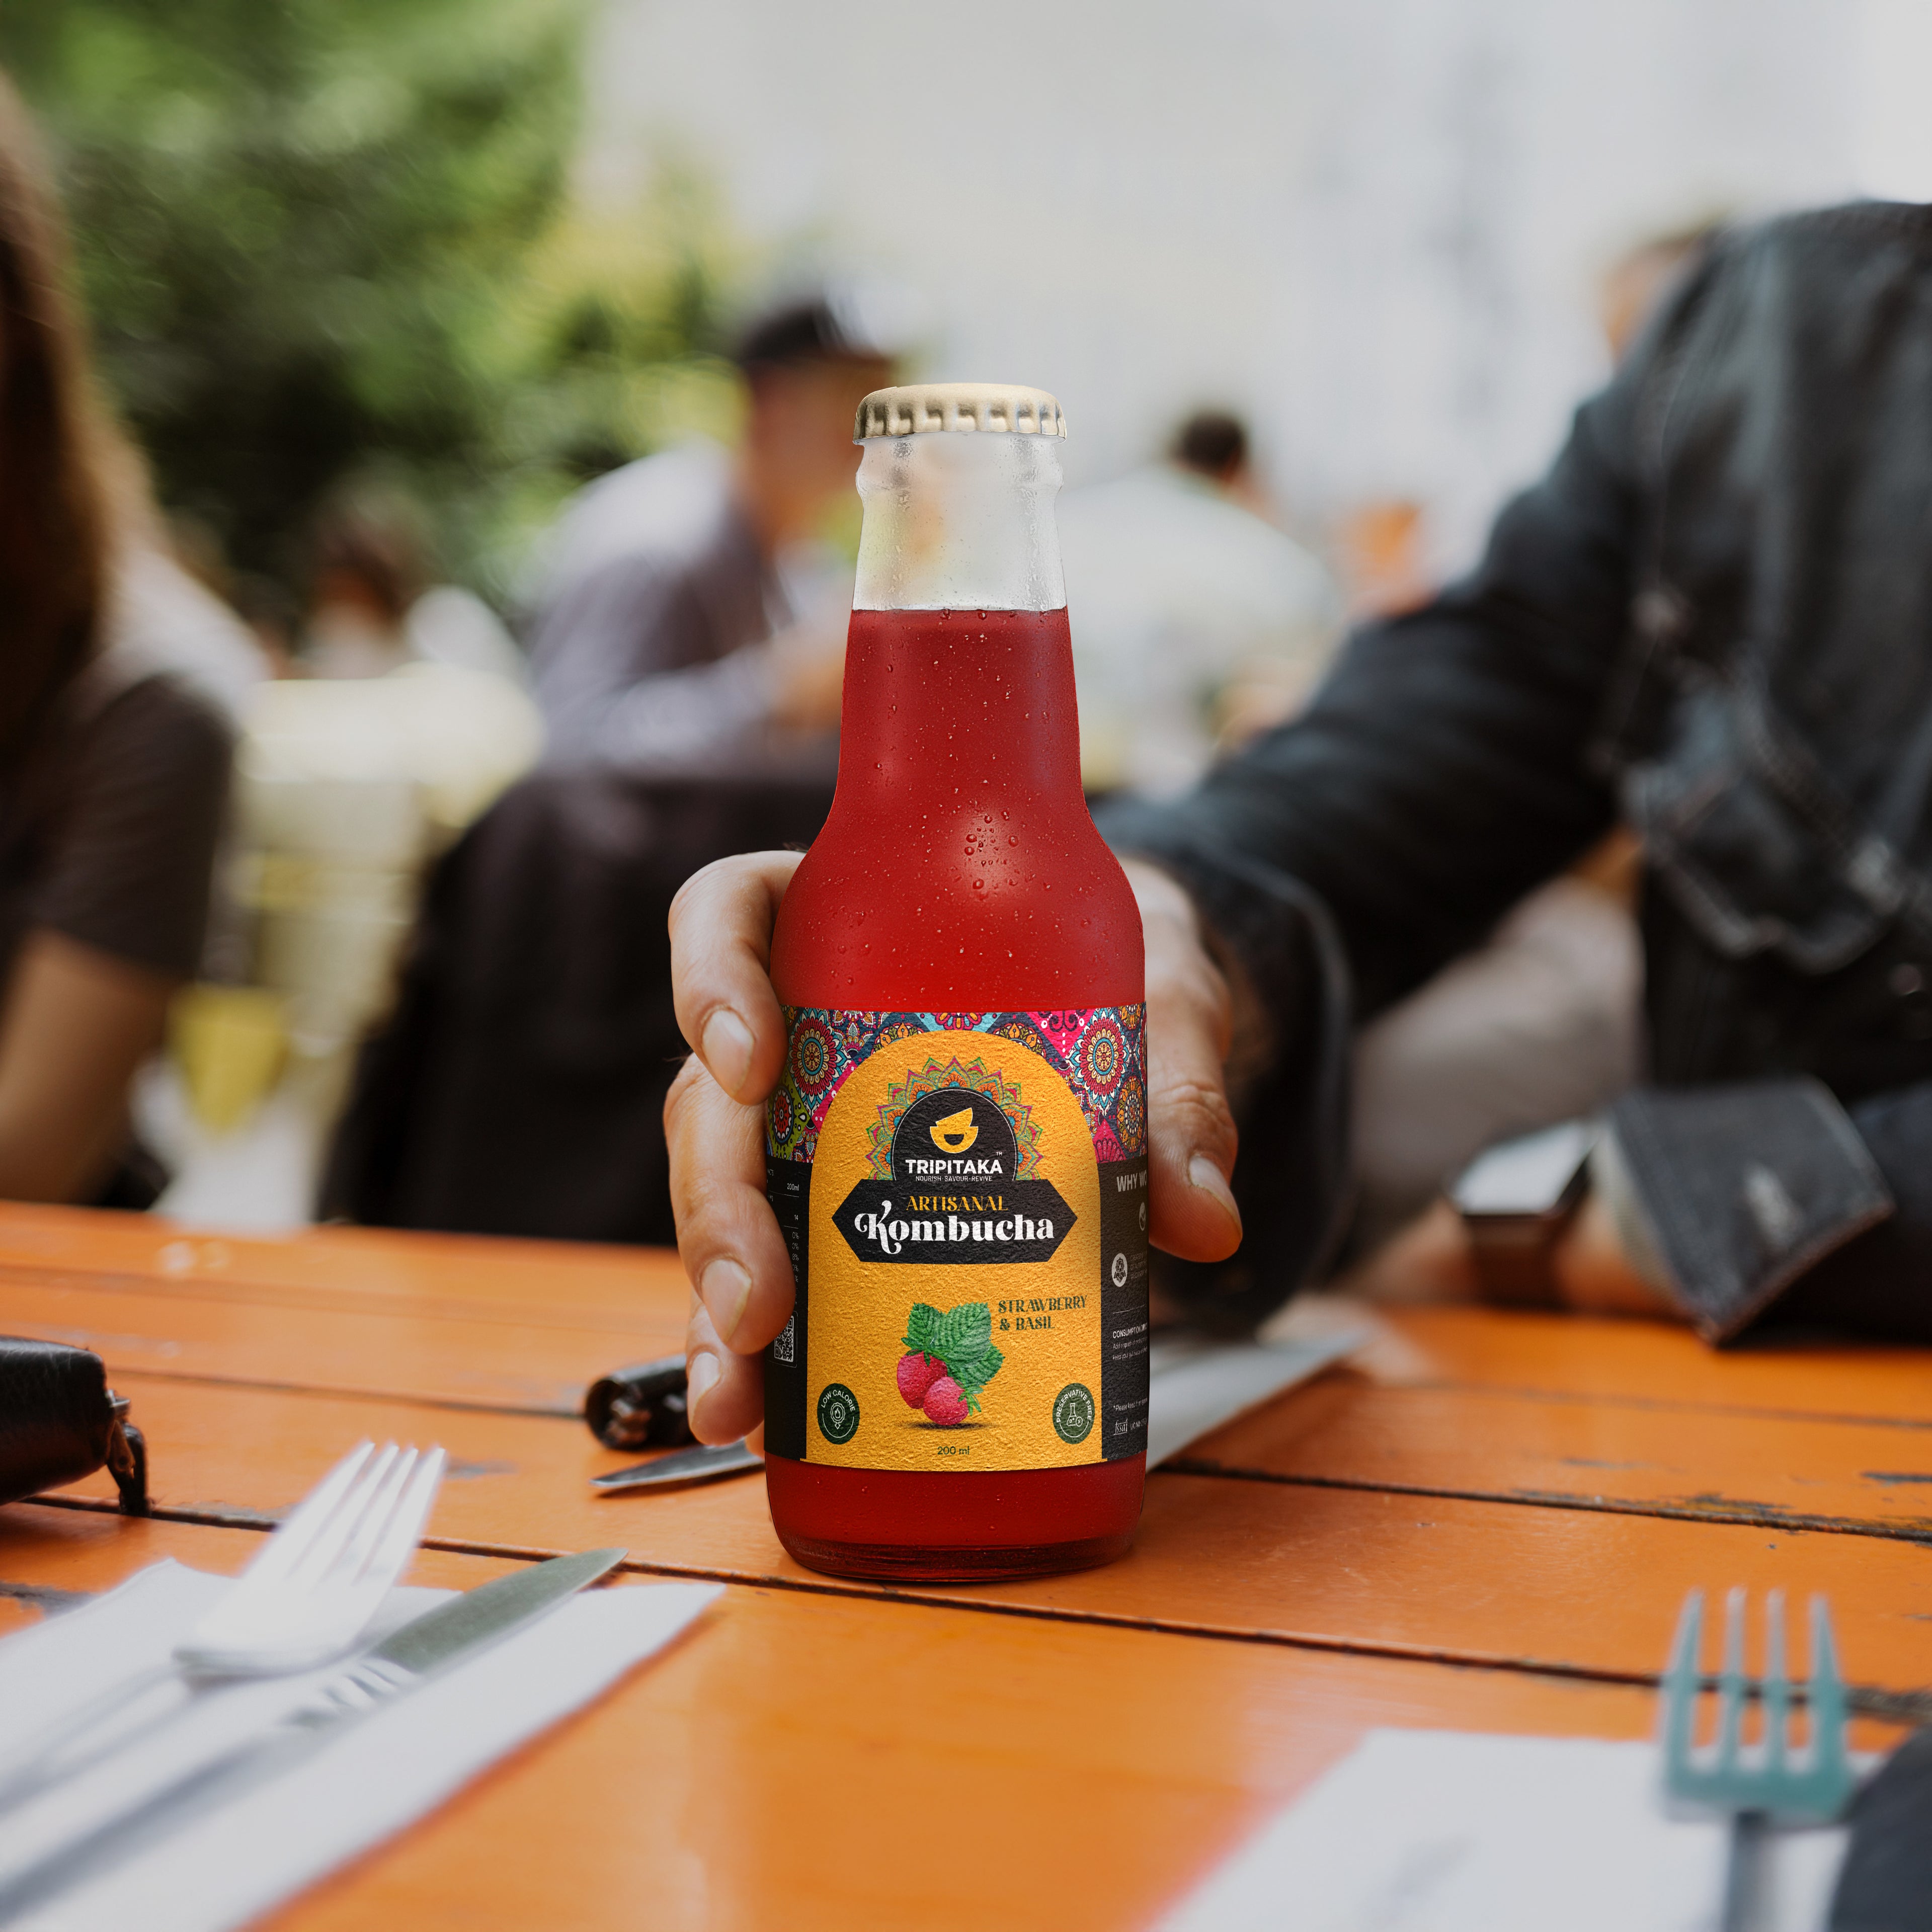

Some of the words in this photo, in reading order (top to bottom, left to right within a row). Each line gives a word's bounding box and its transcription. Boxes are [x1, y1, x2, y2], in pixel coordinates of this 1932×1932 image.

[905, 1159, 1003, 1174] TRIPITAKA
[787, 1183, 799, 1191] 200ml
[1116, 1172, 1138, 1192] WHY
[906, 1196, 1008, 1211] ARTISANAL
[854, 1200, 1055, 1254] Kombucha
[998, 1295, 1087, 1314] STRAWBERRY
[999, 1318, 1011, 1331] &
[1015, 1316, 1055, 1331] BASIL
[1112, 1325, 1141, 1339] CONSUMPTION
[821, 1391, 832, 1408] LOW
[833, 1390, 855, 1412] CALORIE
[1056, 1389, 1088, 1423] PRESERVATIVE
[937, 1446, 956, 1455] 200
[958, 1445, 970, 1455] ml
